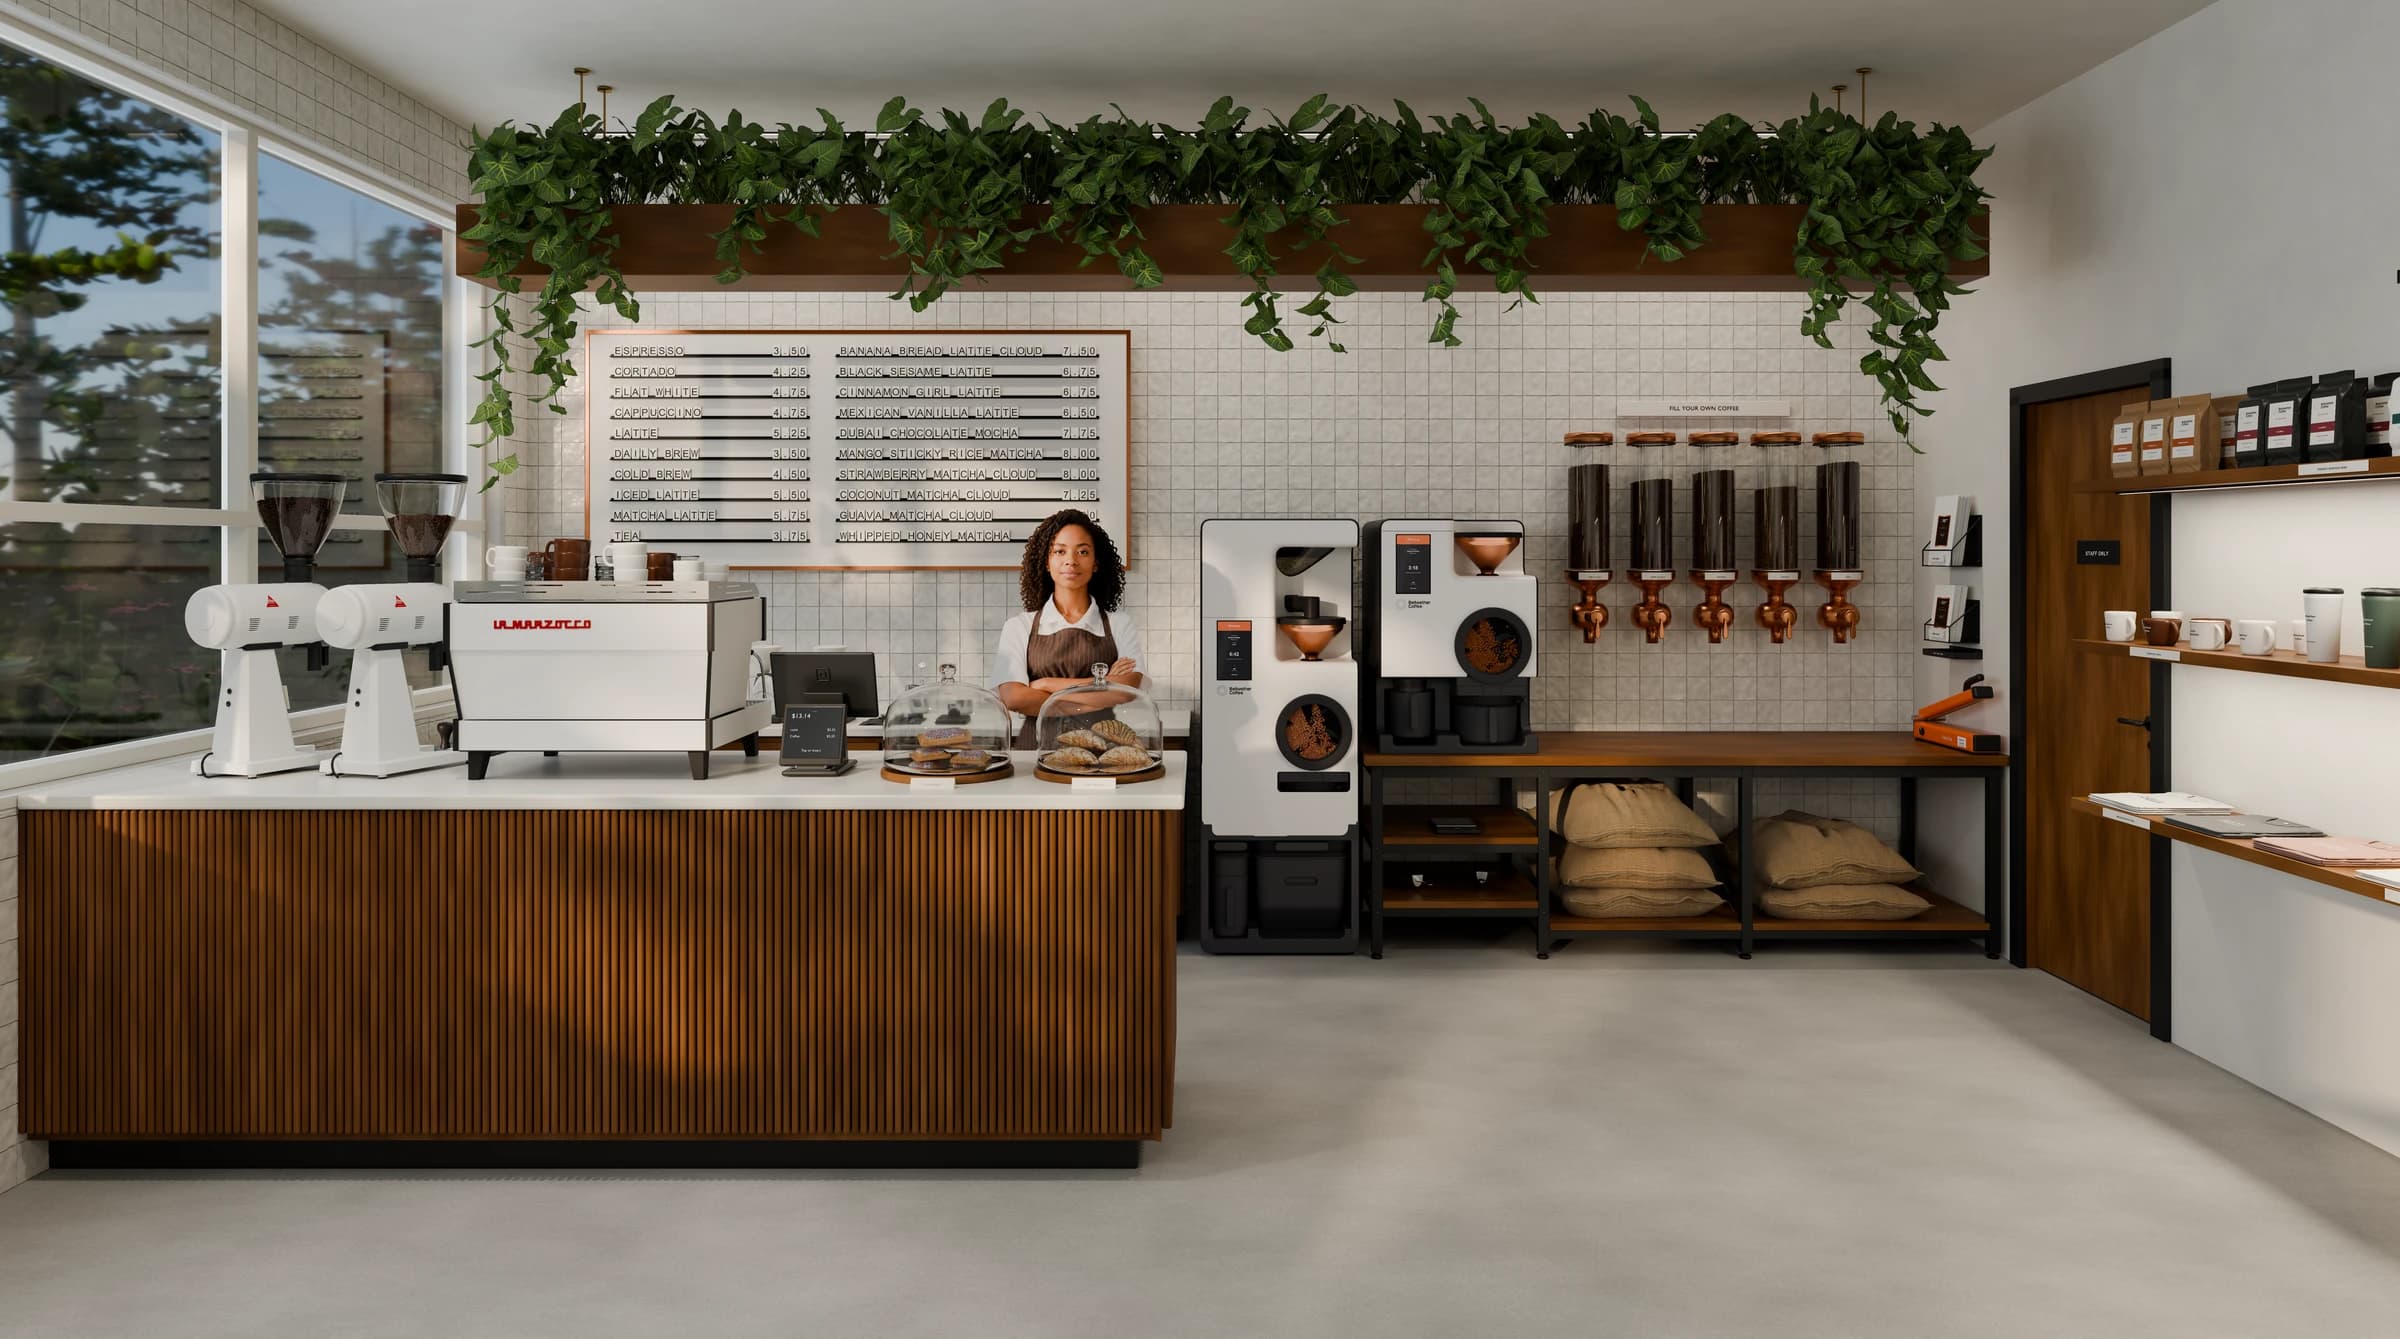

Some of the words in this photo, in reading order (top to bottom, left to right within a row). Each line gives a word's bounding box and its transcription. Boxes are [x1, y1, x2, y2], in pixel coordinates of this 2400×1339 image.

[614, 346, 684, 355] ESPRESSO
[773, 346, 806, 355] 3.50
[840, 346, 891, 355] BANANA
[899, 346, 942, 355] BREAD
[950, 346, 992, 355] LATTE
[999, 346, 1043, 355] CLOUD
[1063, 346, 1096, 355] 7.50
[614, 368, 675, 376] CORTADO
[773, 368, 806, 376] 4.25
[839, 367, 883, 376] BLACK
[890, 367, 942, 376] SESAME
[950, 367, 991, 376] LATTE
[1063, 367, 1096, 376] 6.75
[614, 388, 648, 396] FLAT
[655, 388, 699, 396] WHITE
[773, 388, 806, 396] 4.75
[839, 388, 909, 396] CINNAMON
[916, 388, 950, 396] GIRL
[958, 388, 1000, 396] LATTE
[1063, 388, 1096, 396] 6.75
[614, 408, 701, 417] CAPPUCCINO
[773, 408, 806, 417] 4.75
[839, 408, 900, 417] MEXICAN
[907, 408, 968, 417] VANILLA
[976, 408, 1018, 417] LATTE
[1063, 408, 1096, 417] 6.50
[615, 429, 657, 437] LATTE
[773, 429, 806, 437] 5.25
[839, 429, 881, 438] DUBAI
[890, 429, 968, 438] CHOCOLATE
[975, 429, 1018, 438] MOCHA
[1063, 429, 1096, 438] 7.75
[614, 450, 657, 458] DAILY
[665, 450, 700, 458] BREW
[773, 450, 806, 458] 3.50
[839, 450, 883, 458] MANGO
[889, 450, 942, 458] STICKY
[950, 450, 983, 458] RICE
[990, 450, 1042, 458] MATCHA
[1063, 450, 1096, 458] 8.00
[614, 470, 649, 478] COLD
[656, 470, 692, 478] BREW
[773, 470, 806, 478] 4.50
[839, 470, 926, 479] STRAWBERRY
[933, 470, 985, 479] MATCHA
[993, 470, 1036, 479] CLOUD
[1063, 470, 1096, 479] 8.00
[616, 490, 648, 499] ICED
[656, 490, 698, 499] LATTE
[773, 490, 806, 499] 5.50
[839, 490, 900, 499] COCONUT
[907, 490, 959, 499] MATCHA
[966, 490, 1009, 499] CLOUD
[1063, 490, 1096, 499] 7.25
[613, 511, 666, 520] MATCHA
[673, 511, 715, 520] LATTE
[773, 511, 806, 520] 5.75
[839, 511, 882, 520] GUAVA
[890, 511, 942, 520] MATCHA
[949, 511, 992, 520] CLOUD
[614, 532, 640, 540] TEA
[773, 532, 806, 540] 3.75
[839, 532, 900, 540] WHIPPED
[908, 532, 950, 540] HONEY
[957, 532, 1010, 540] MATCHA
